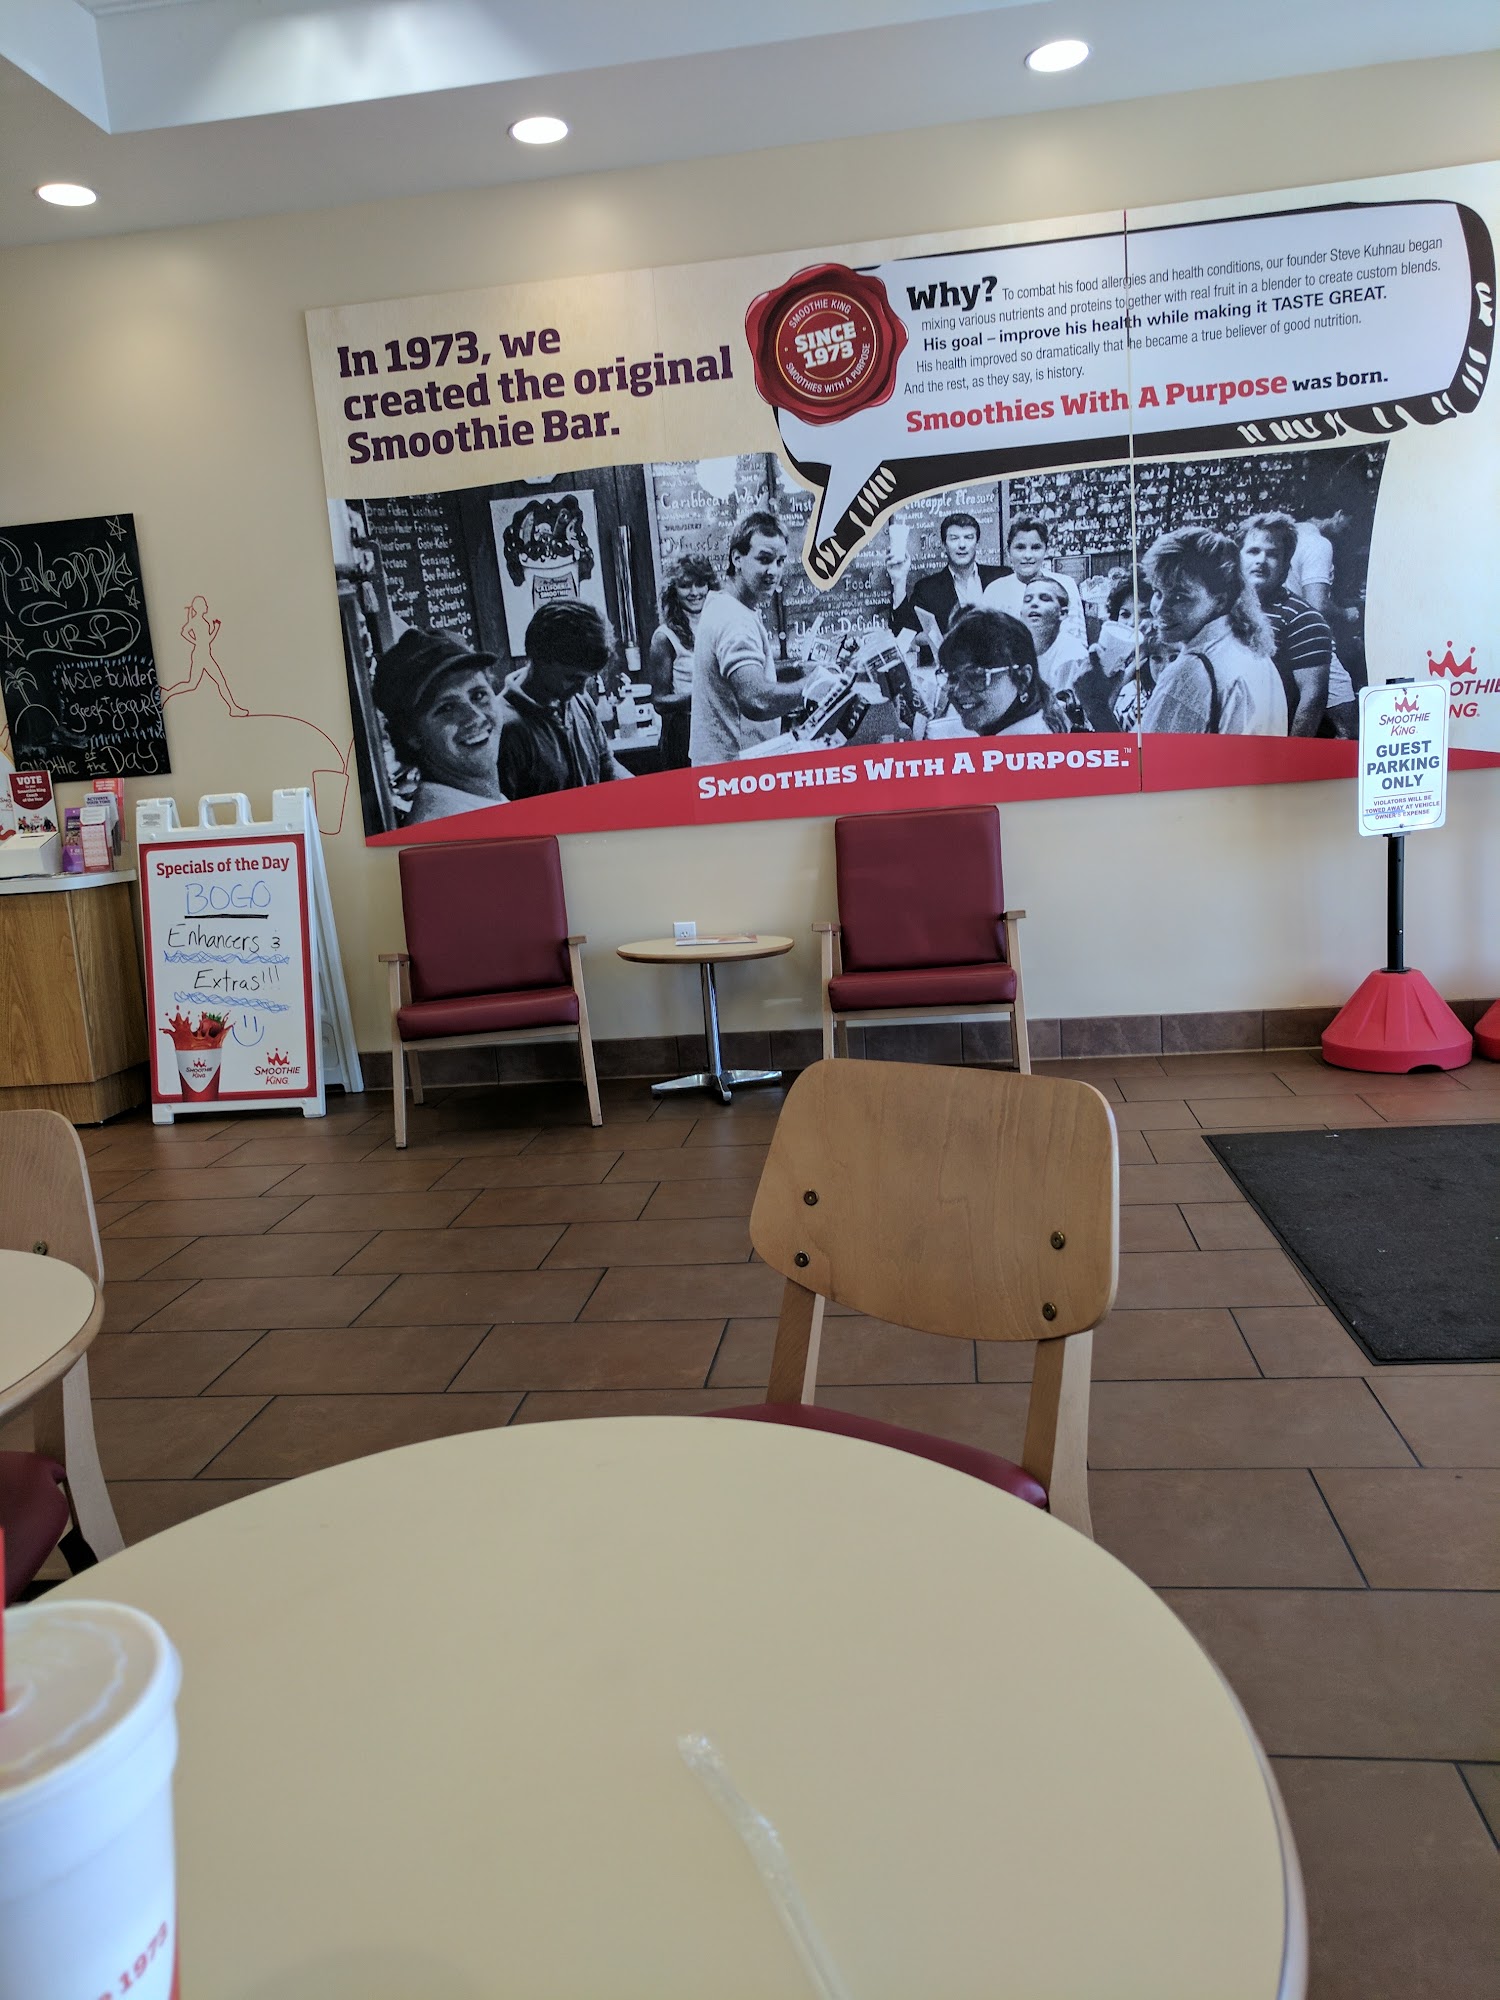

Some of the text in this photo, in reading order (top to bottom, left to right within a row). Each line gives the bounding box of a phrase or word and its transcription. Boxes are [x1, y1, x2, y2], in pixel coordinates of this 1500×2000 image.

[906, 238, 1443, 312] Why? To combat his food allergies and health conditions, our founder Steve Kuhnau began
[921, 316, 956, 332] mixing
[958, 312, 996, 327] various
[999, 306, 1045, 323] nutrients
[1047, 303, 1067, 317] and
[1070, 298, 1112, 315] proteins
[1164, 290, 1187, 303] with
[1190, 286, 1211, 300] real
[1213, 282, 1235, 297] fruit
[1237, 280, 1248, 294] in
[1251, 282, 1258, 293] a
[1261, 274, 1302, 291] blender
[1305, 273, 1315, 287] to
[1318, 270, 1353, 285] create
[1356, 265, 1398, 281] custom
[1400, 259, 1441, 275] blends.
[789, 298, 852, 329] SMOOTHIE KING
[924, 337, 947, 352] His
[951, 333, 984, 351] goal
[999, 325, 1061, 345] improve
[1065, 321, 1087, 336] his
[1091, 315, 1142, 333] health
[1147, 310, 1189, 327] while
[1193, 303, 1252, 321] making
[1257, 300, 1267, 314] it
[1272, 293, 1324, 312] TASTE
[1328, 285, 1387, 305] GREAT.
[794, 321, 857, 353] SINCE
[916, 312, 1362, 373] His health improved so dramatically that he became a true believer of good nutrition.
[337, 328, 561, 378] In 1973, we
[803, 341, 854, 369] 1973
[344, 345, 734, 421] created the original
[786, 343, 871, 394] SMOOTHIES WITH A PURPOSE
[904, 364, 1085, 395] And the rest, as they say, is history.
[906, 369, 1389, 433] Smoothies With A Purpose was born.
[347, 408, 620, 465] Smoothie Bar.
[1379, 712, 1430, 726] SMOOTHIE
[951, 751, 976, 775] A
[1376, 740, 1432, 758] GUEST
[16, 776, 43, 785] VOTE
[1367, 755, 1440, 776] PARKING
[1381, 773, 1424, 790] ONLY
[1373, 797, 1406, 806] VIOLATORS
[1403, 809, 1430, 817] EXPENSE
[156, 856, 290, 879] Specials of the Day
[167, 924, 260, 954] Enhancers
[254, 1066, 301, 1075] SMOOTHIE
